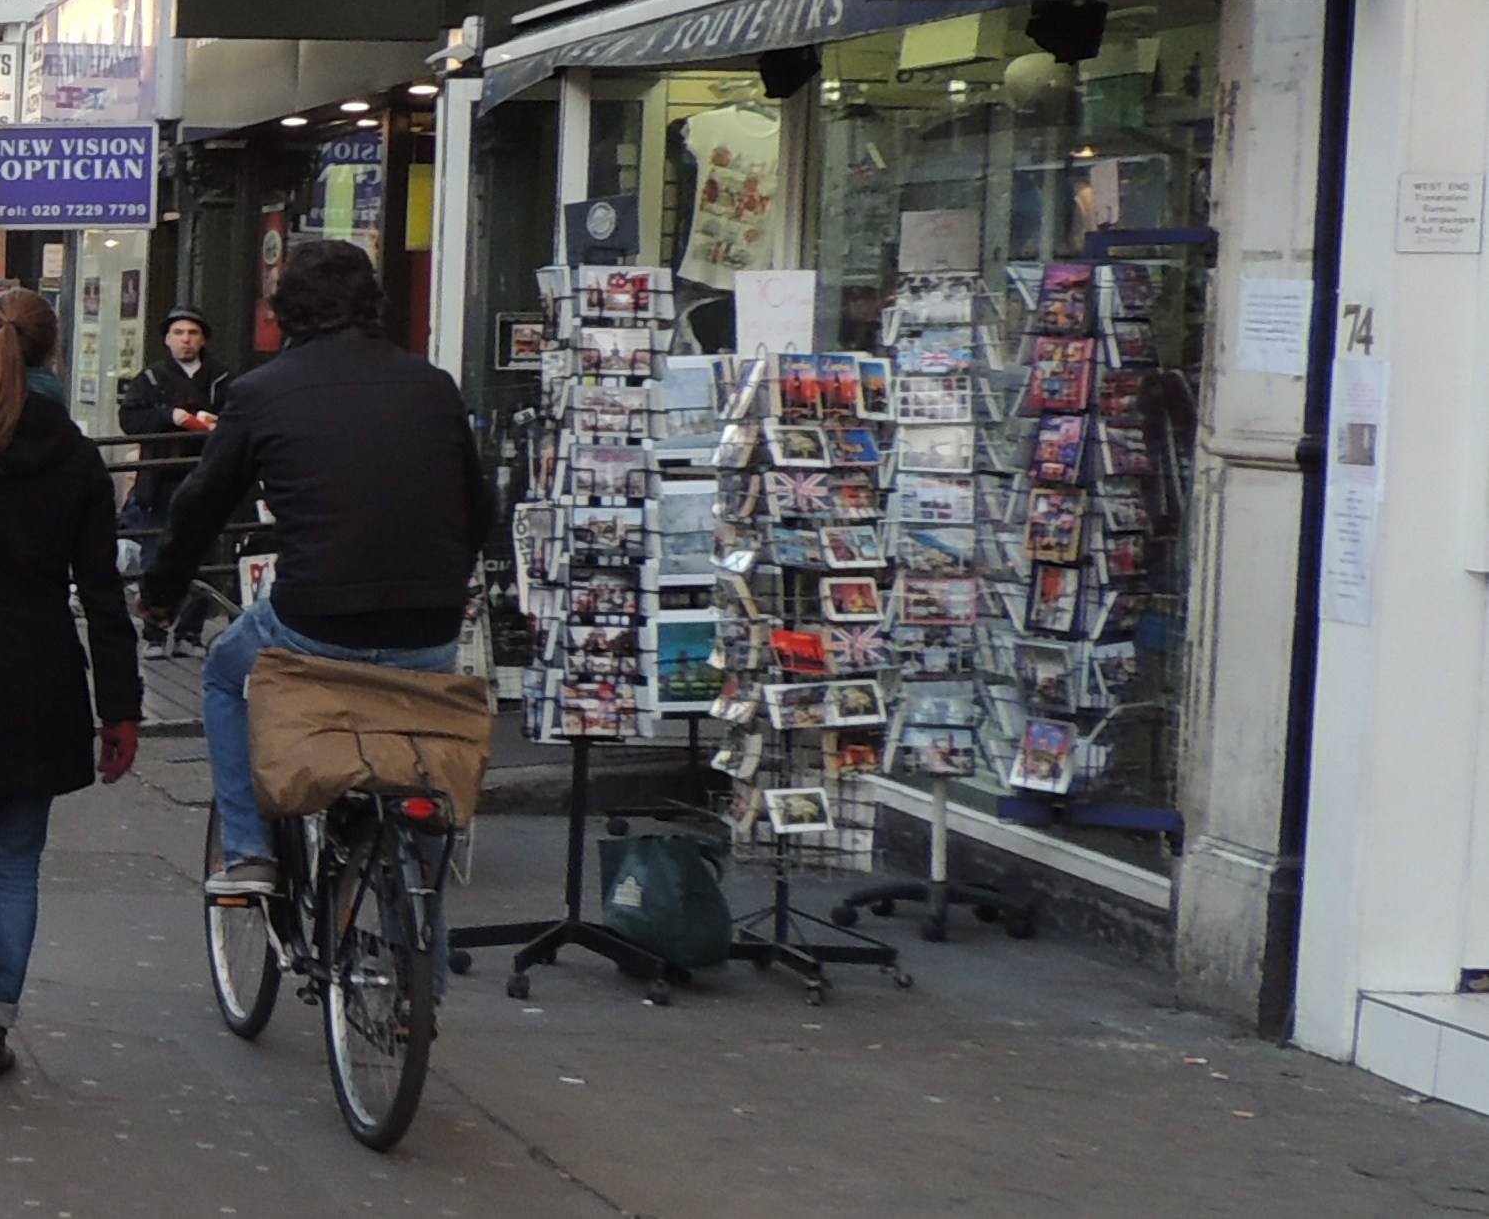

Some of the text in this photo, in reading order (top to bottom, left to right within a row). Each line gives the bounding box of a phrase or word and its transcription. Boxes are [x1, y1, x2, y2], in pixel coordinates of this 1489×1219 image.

[0, 137, 146, 156] NEW VISION
[0, 159, 144, 180] OPTICIAN
[1413, 182, 1470, 191] WEST END
[31, 204, 61, 216] 020
[66, 204, 104, 216] 7229
[108, 203, 147, 216] 7799
[1343, 304, 1375, 356] 74
